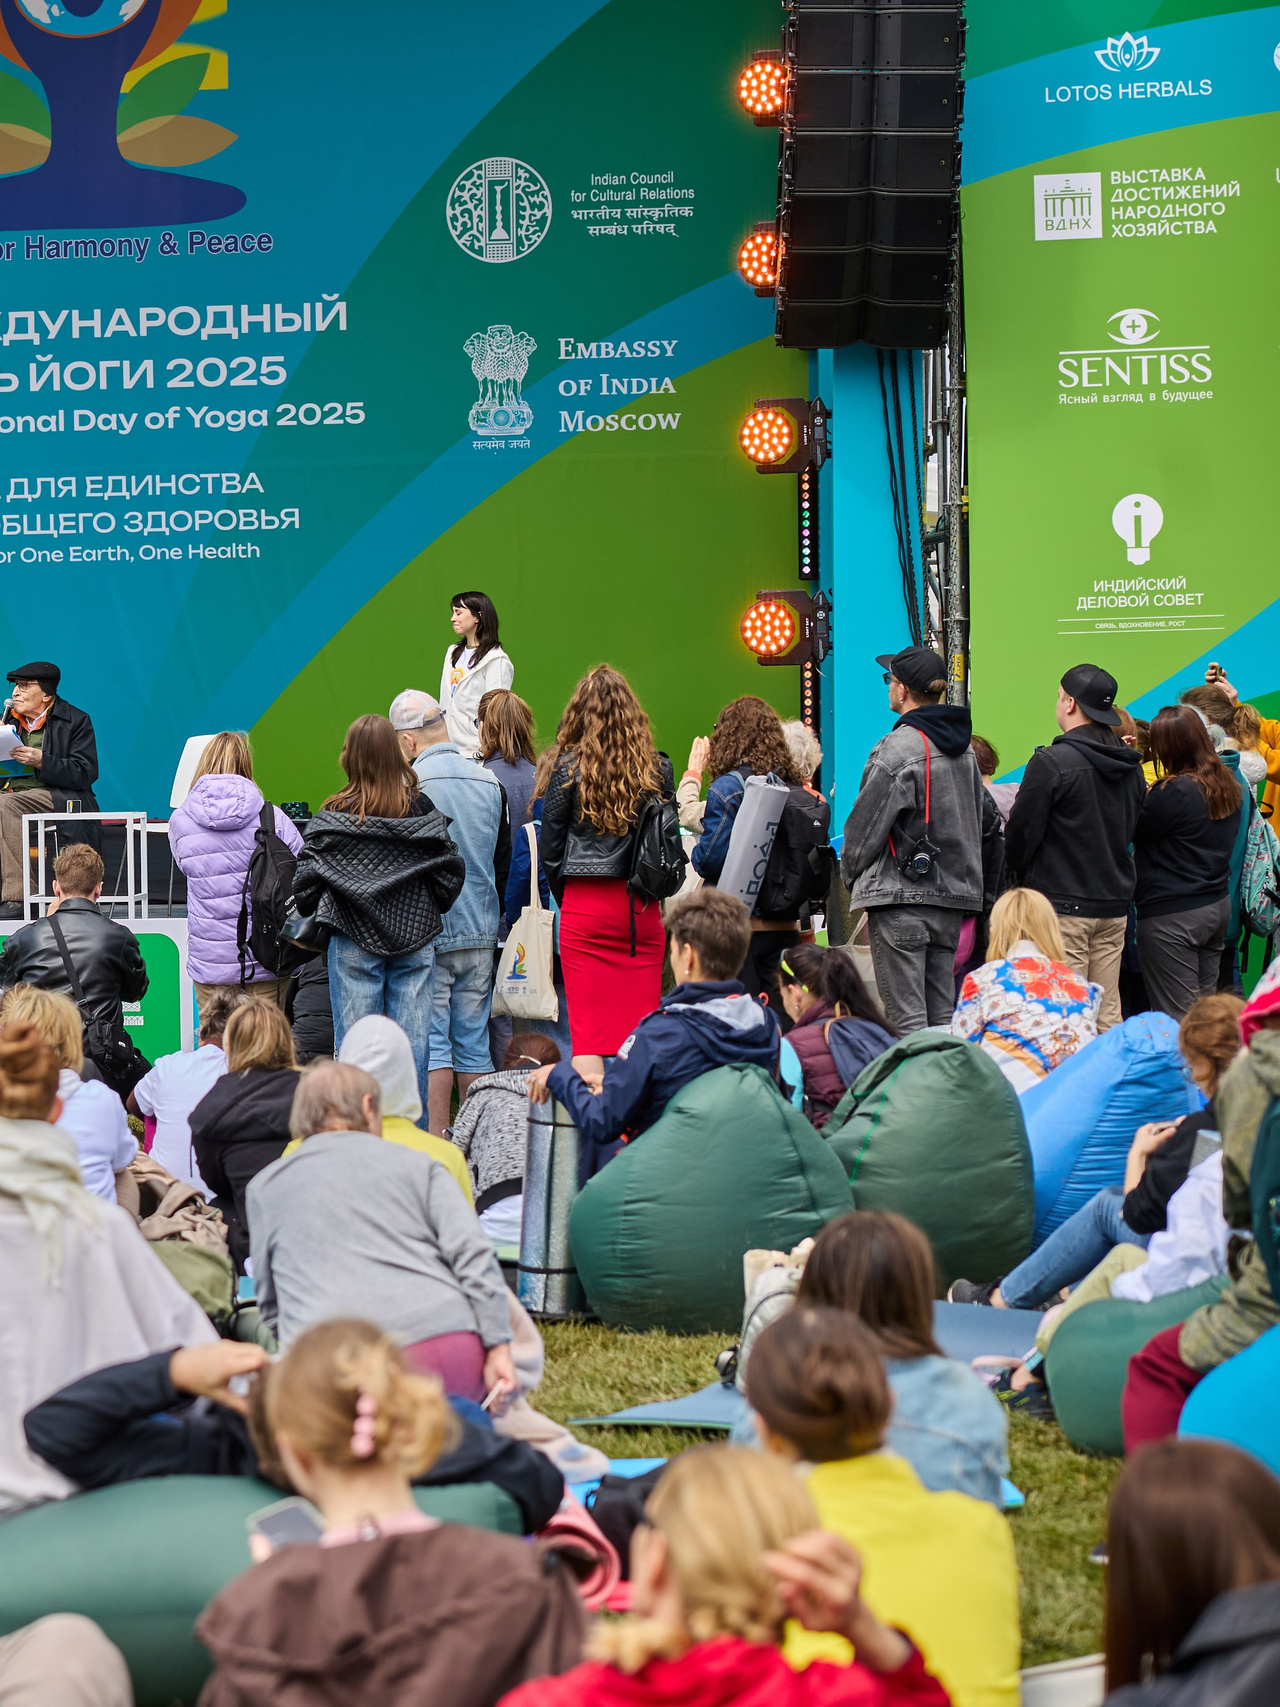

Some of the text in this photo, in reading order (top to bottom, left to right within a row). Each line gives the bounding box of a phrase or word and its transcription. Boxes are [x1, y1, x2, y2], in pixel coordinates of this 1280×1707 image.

[1045, 78, 1213, 103] LOTOS HERBALS
[591, 170, 674, 186] Indian Council
[1110, 167, 1206, 185] ВЫСТАВКА
[570, 186, 695, 203] for Cultural Relations
[1110, 181, 1240, 203] ДОСТИЖЕНИЙ
[571, 205, 622, 220] भारतीय
[1111, 202, 1226, 220] НАРОДНОГО
[1044, 217, 1093, 232] ВДНХ
[1111, 219, 1218, 238] ХОЗЯЙСТВА
[23, 231, 152, 266] Harmony
[158, 230, 180, 257] &
[187, 229, 275, 257] Peace
[557, 337, 679, 360] EMBASSY
[29, 353, 155, 392] ЙОГИ
[166, 355, 287, 389] 2025
[1058, 351, 1213, 388] SENTISS
[558, 373, 677, 397] OF INDIA
[1058, 389, 1214, 405] Ясный взгляд в будущее
[73, 409, 139, 435] Day
[144, 405, 181, 430] of
[185, 405, 269, 432] Yoga
[276, 401, 366, 426] 2025
[559, 410, 682, 433] MOSCOW
[472, 439, 531, 450] सत्यमेव जयते
[6, 476, 77, 503] ДЛЯ
[85, 472, 265, 501] ЕДИНСТВА
[123, 507, 300, 537] ЗДОРОВЬЯ
[19, 547, 64, 563] One
[69, 545, 135, 563] Earth,
[138, 544, 183, 561] One
[188, 542, 261, 560] Health
[1093, 575, 1187, 593] ИНДИЙСКИЙ
[1076, 592, 1205, 611] ДЕЛОВОЙ СОВЕТ
